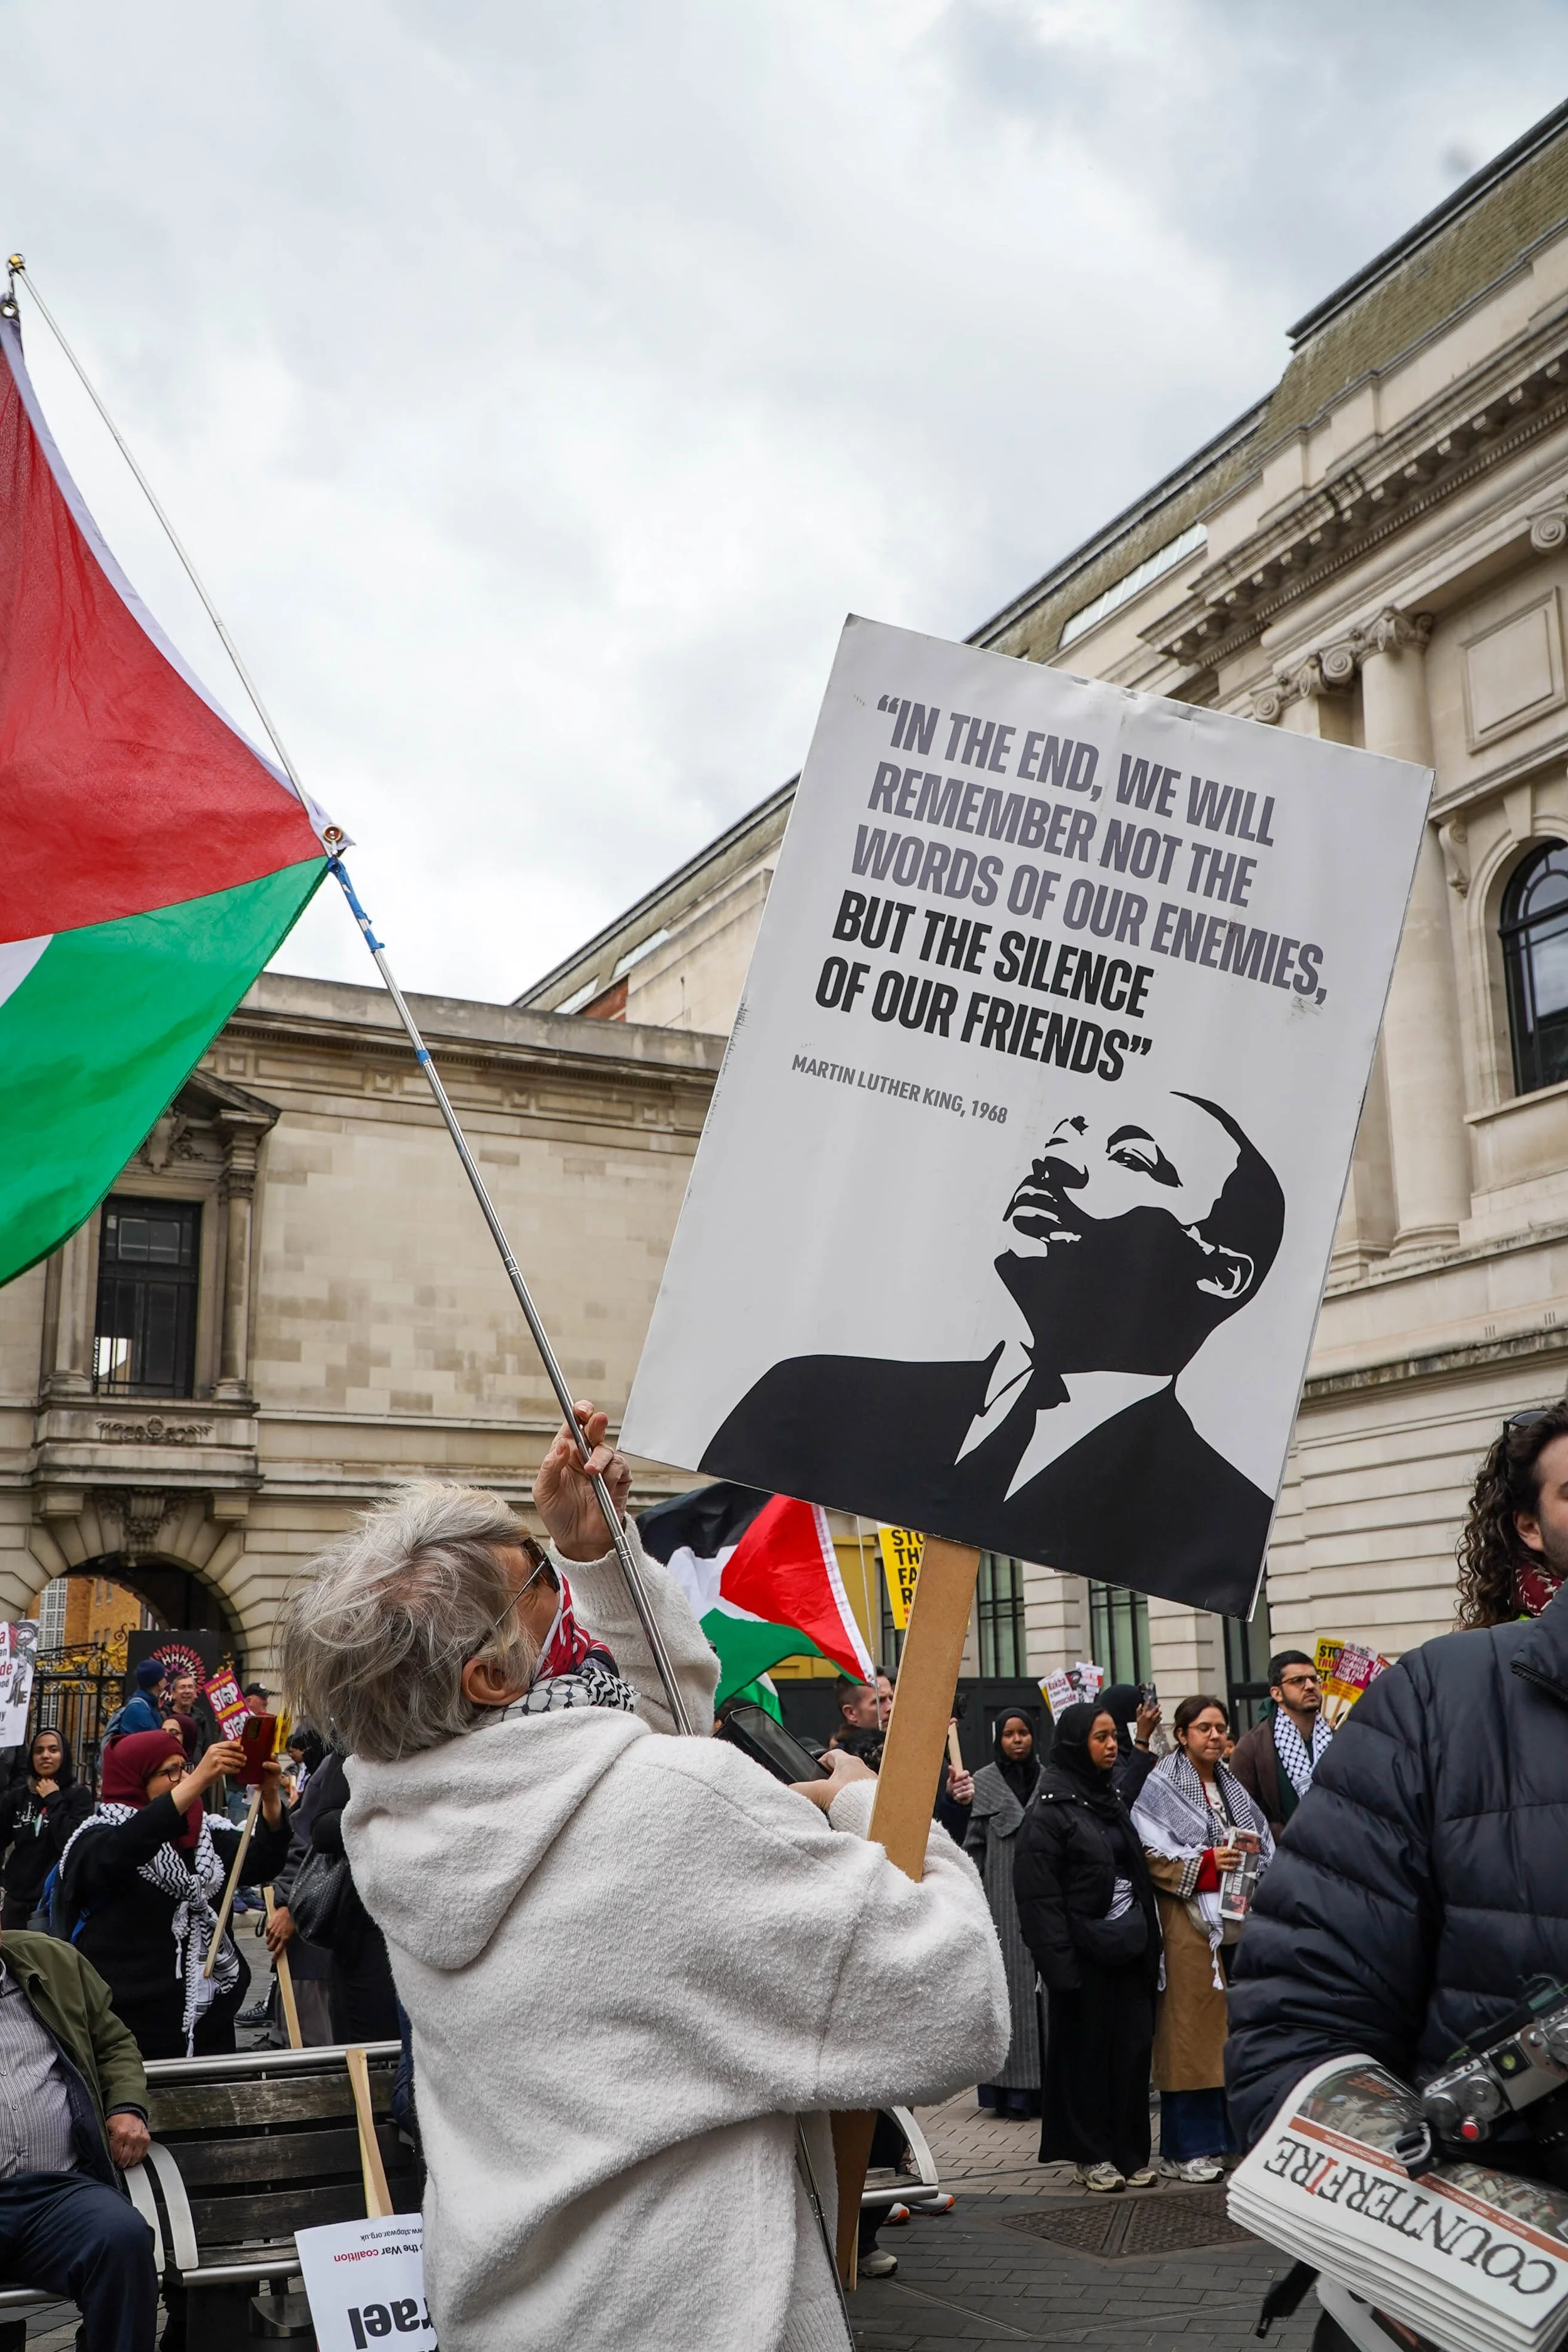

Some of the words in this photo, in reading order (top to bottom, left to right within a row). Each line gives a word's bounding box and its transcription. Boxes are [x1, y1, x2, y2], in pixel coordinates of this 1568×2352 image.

[877, 695, 940, 755] “IN
[945, 712, 1016, 773] THE
[1017, 731, 1102, 802] END,
[1116, 753, 1181, 818] WE
[1187, 776, 1274, 847] WILL
[867, 761, 1097, 862] REMEMBER
[1099, 818, 1183, 885] NOT
[1187, 843, 1258, 908] THE
[852, 824, 1004, 906] WORDS
[1007, 865, 1061, 920] OF
[1063, 879, 1148, 946] OUR
[1150, 902, 1327, 1005] ENEMIES,
[832, 889, 916, 954] BUT
[919, 909, 992, 975] THE
[993, 931, 1154, 1018] SILENCE
[815, 956, 871, 1012] OF
[872, 970, 958, 1037] OUR
[960, 992, 1152, 1081] FRIENDS”
[792, 1055, 856, 1084] MARTIN
[857, 1071, 920, 1101] LUTHER
[923, 1088, 968, 1118] KING,
[972, 1101, 1007, 1123] 1968
[894, 1547, 922, 1565] TH
[898, 1567, 918, 1585] FA
[210, 1682, 238, 1712] STOP
[360, 2228, 423, 2242] ww.stopwar.org.uk
[1264, 2136, 1557, 2295] COUNTERFIRE
[334, 2249, 379, 2262] coalition
[381, 2245, 402, 2255] War
[404, 2244, 418, 2253] the
[347, 2297, 435, 2350] rael
